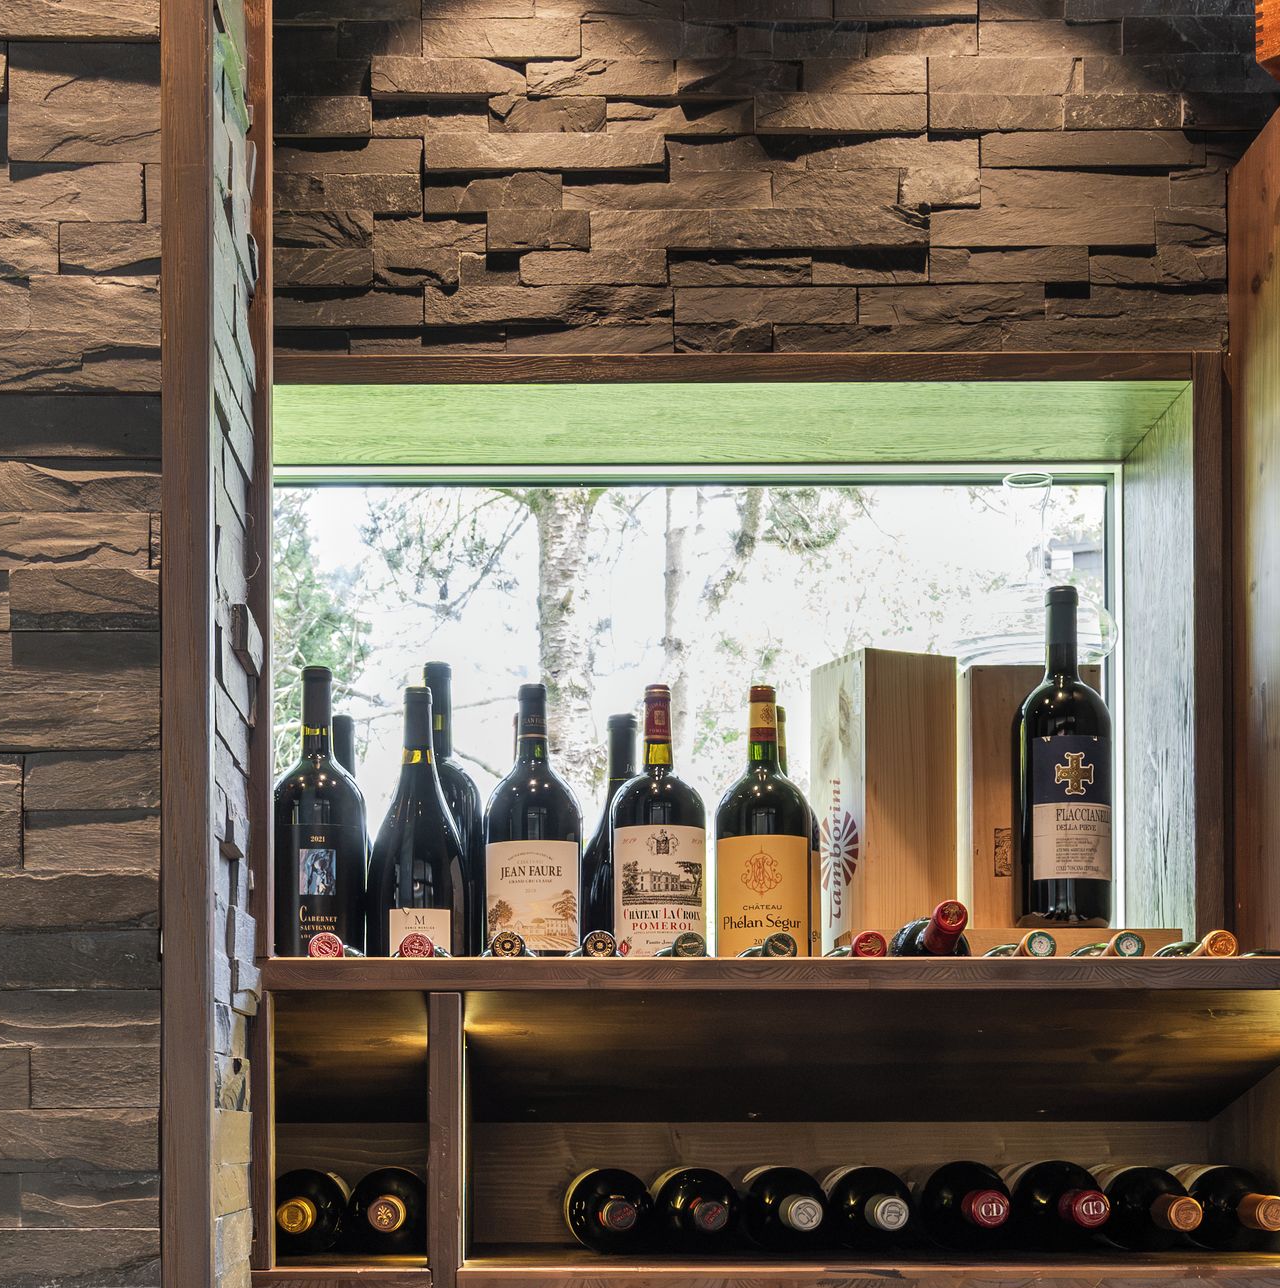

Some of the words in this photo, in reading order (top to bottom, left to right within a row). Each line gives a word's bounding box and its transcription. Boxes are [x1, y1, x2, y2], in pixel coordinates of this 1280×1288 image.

[310, 836, 326, 844] 2021
[500, 864, 526, 880] JEAN
[530, 864, 563, 878] FAURE
[742, 902, 782, 912] CHÂTEAU
[299, 904, 338, 924] CABERNET
[624, 907, 661, 922] CHÂTEAU
[664, 907, 676, 921] LA
[677, 907, 702, 922] CROIX
[414, 915, 426, 926] M
[723, 913, 764, 932] Phélan
[766, 913, 802, 932] Ségur
[300, 924, 337, 932] SAUVIGNON
[632, 922, 694, 932] POMEROL
